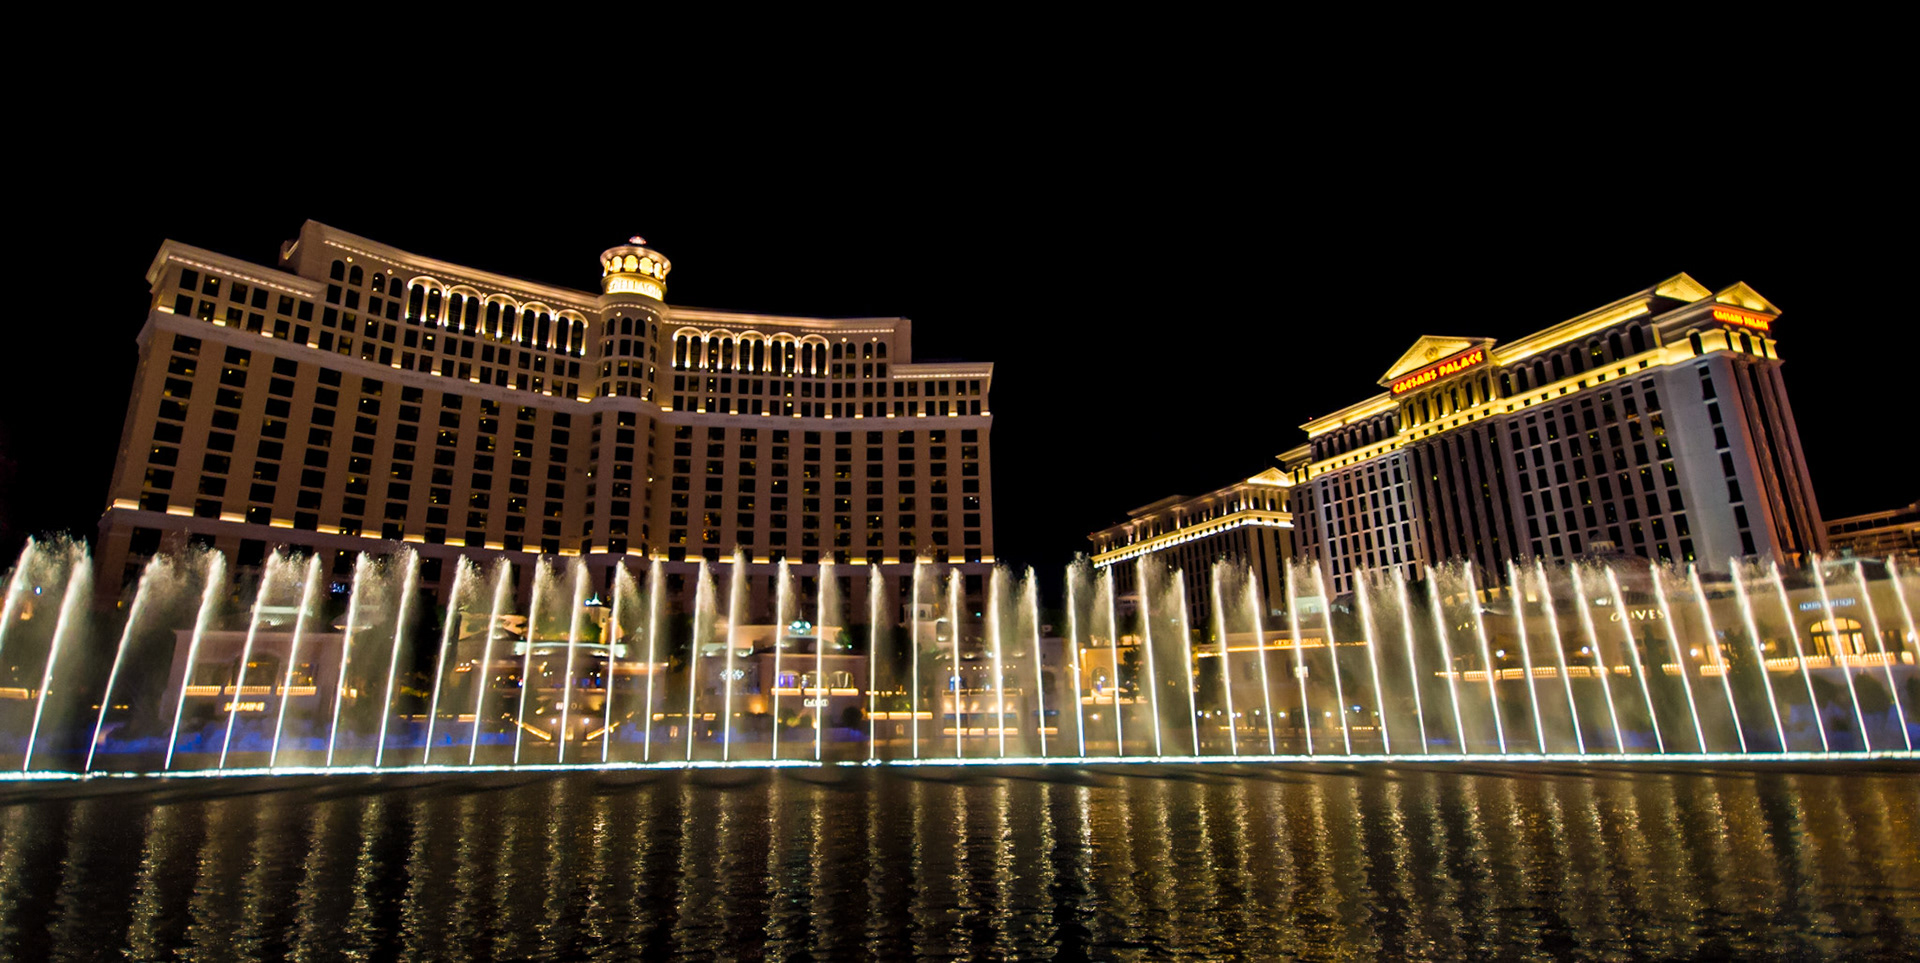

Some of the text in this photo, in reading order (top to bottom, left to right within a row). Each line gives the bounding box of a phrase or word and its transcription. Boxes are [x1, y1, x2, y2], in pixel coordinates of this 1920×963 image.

[1392, 350, 1483, 394] CAESARS PALACE
[1610, 608, 1665, 622] OIVES
